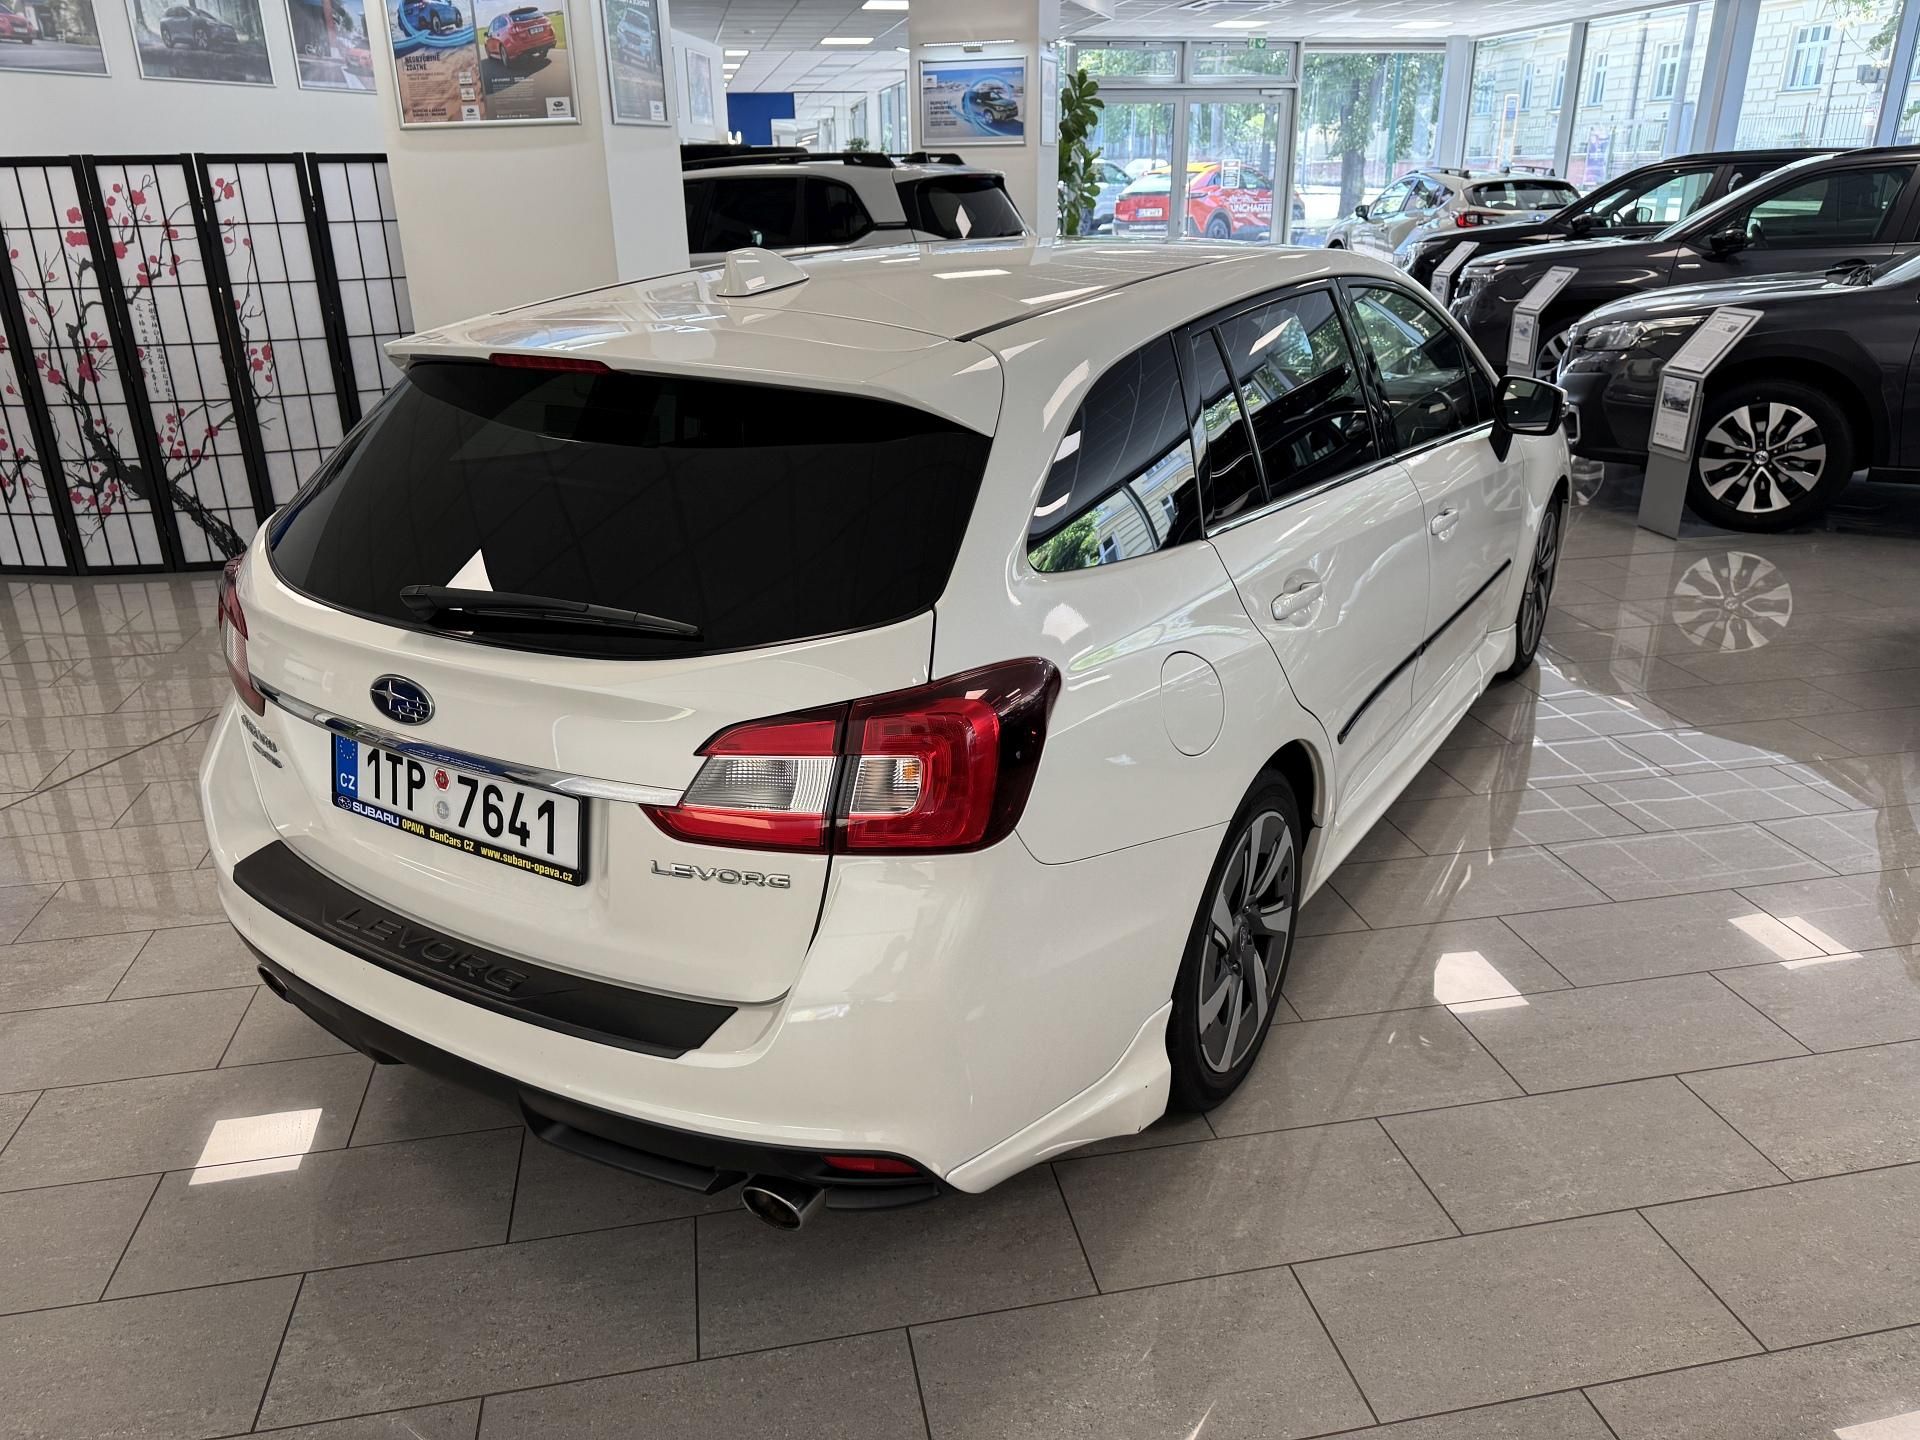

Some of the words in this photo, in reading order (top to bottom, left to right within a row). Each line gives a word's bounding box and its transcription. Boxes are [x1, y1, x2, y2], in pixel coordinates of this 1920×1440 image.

[340, 772, 356, 790] CZ
[367, 748, 426, 812] 1TP
[457, 774, 555, 856] 7641
[352, 801, 400, 827] SUBARU
[401, 818, 425, 836] OPAVA
[429, 828, 462, 848] DanCars
[463, 839, 475, 852] CZ
[480, 846, 573, 882] www.subaru-opava.cz
[650, 859, 791, 889] LEVORG
[336, 908, 530, 993] LEVORG
